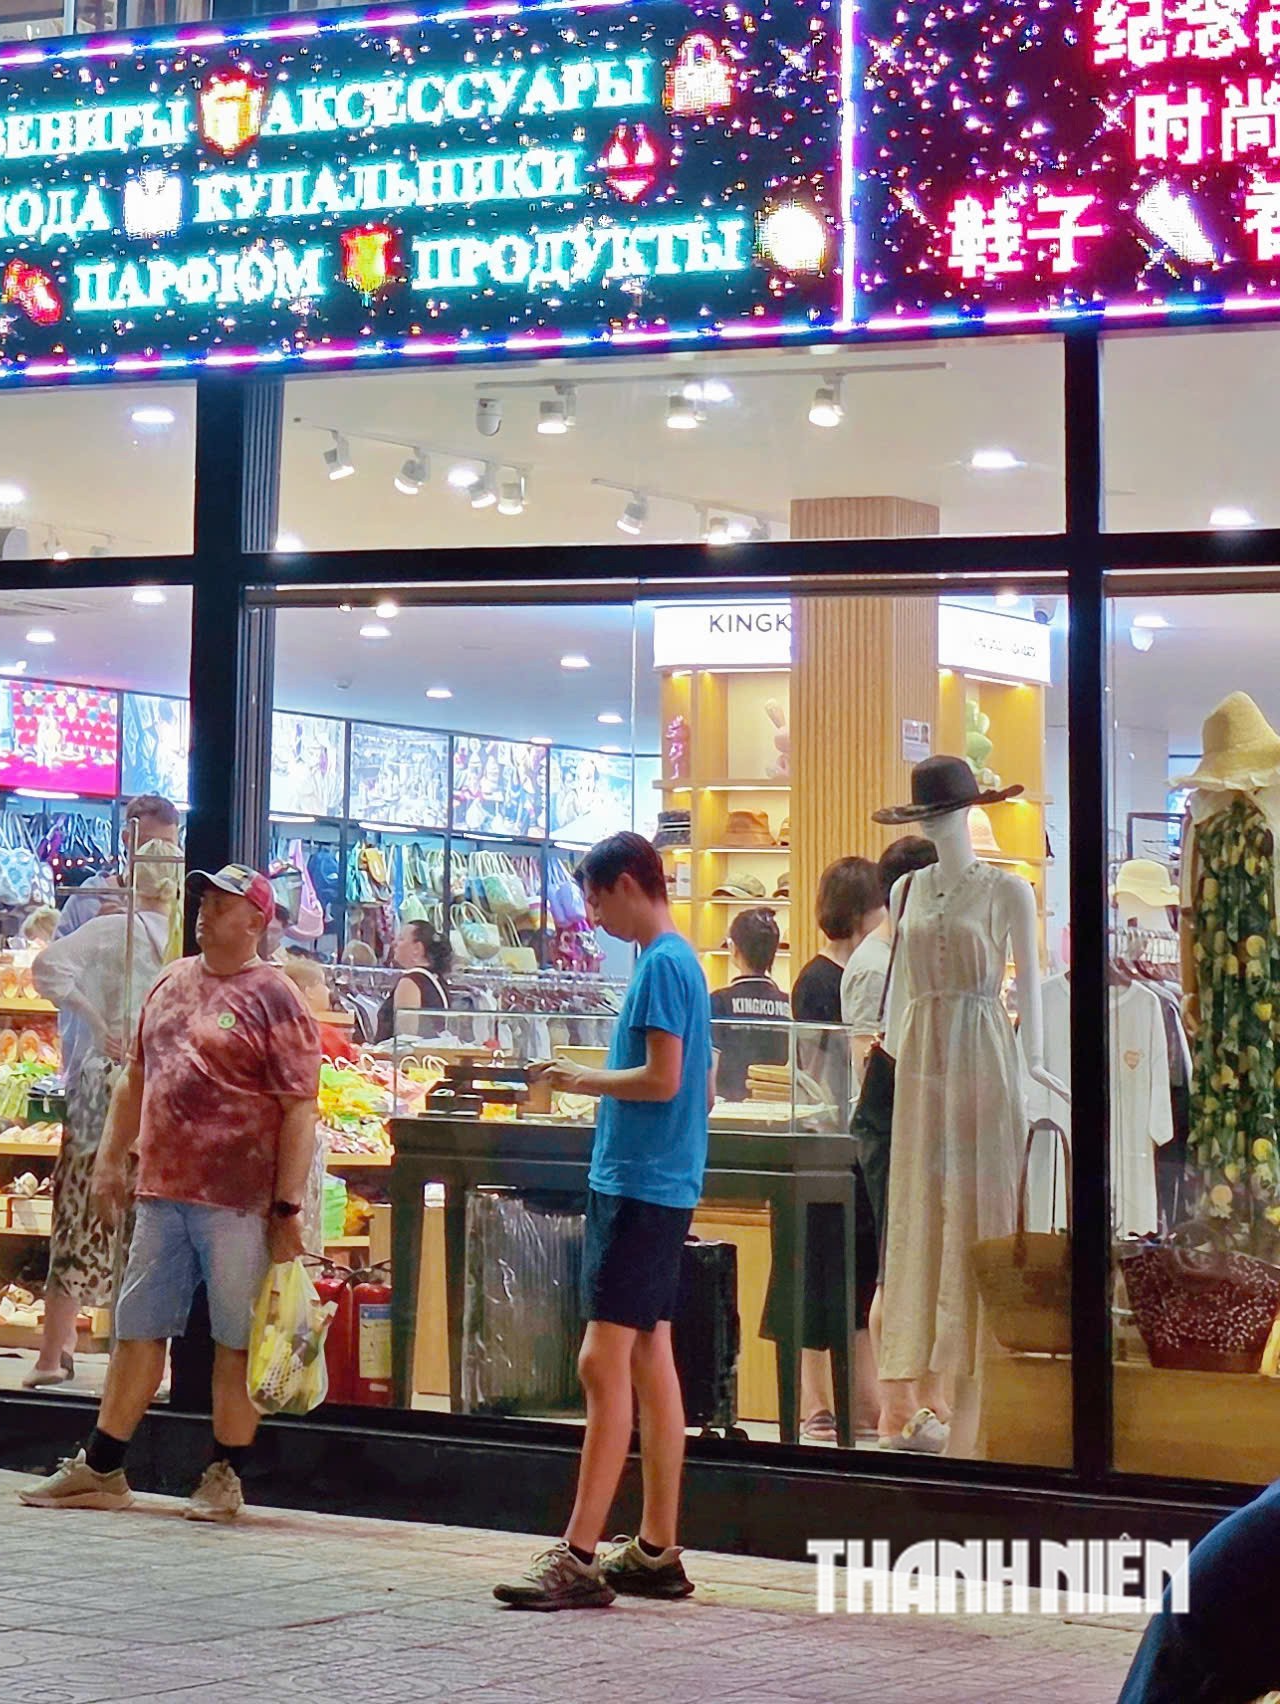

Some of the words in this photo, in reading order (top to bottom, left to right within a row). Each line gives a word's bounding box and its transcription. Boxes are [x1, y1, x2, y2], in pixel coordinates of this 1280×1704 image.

[261, 57, 651, 136] АКСЕССУАРЫ
[1135, 78, 1280, 164] 时尚
[193, 149, 585, 223] КУПАЛЬНИКИ
[74, 248, 325, 312] ПАРФЮМ
[412, 220, 746, 293] ПРОДУКТЫ
[948, 195, 1103, 278] 鞋子
